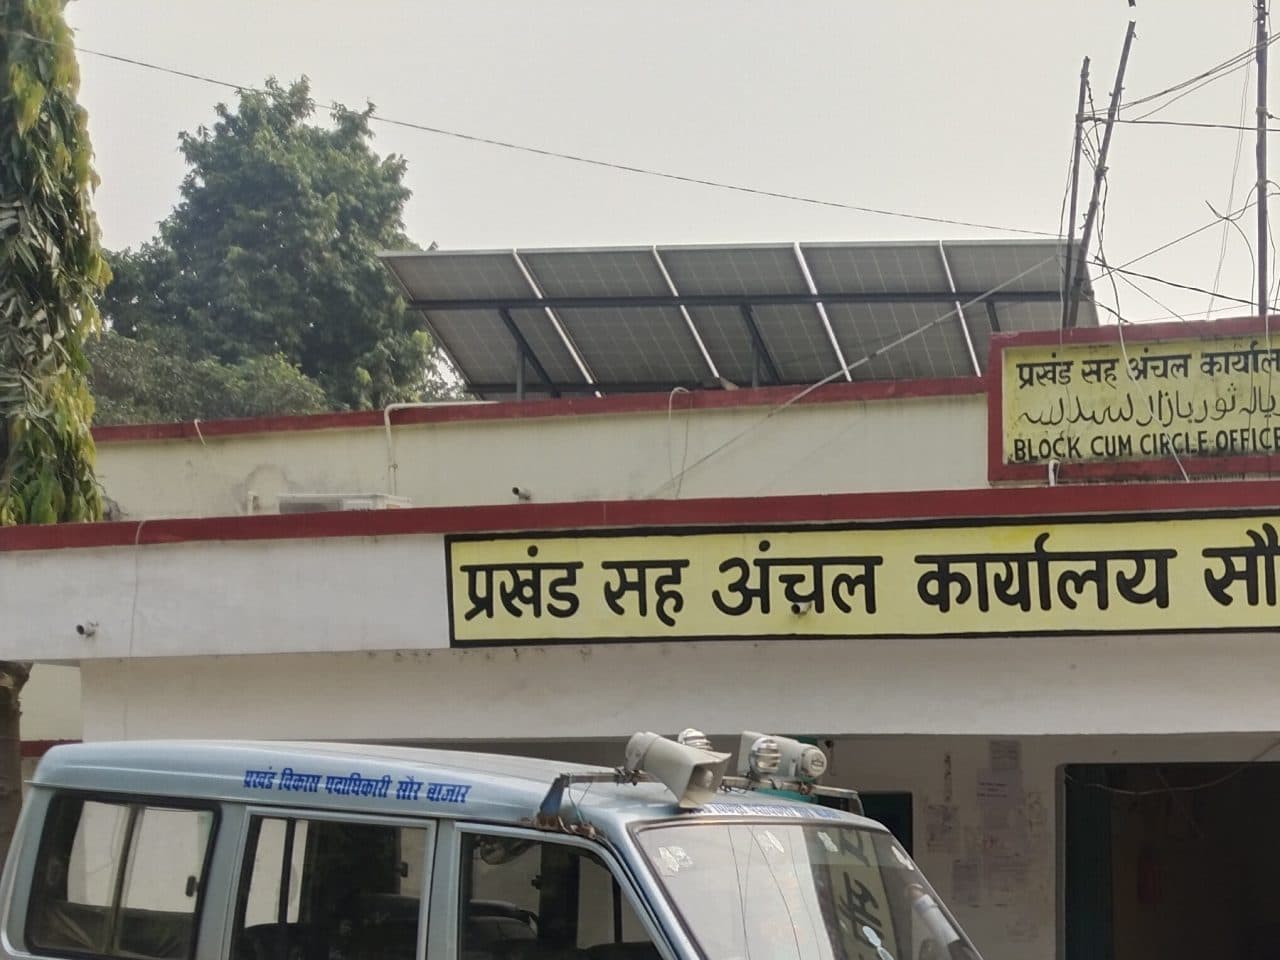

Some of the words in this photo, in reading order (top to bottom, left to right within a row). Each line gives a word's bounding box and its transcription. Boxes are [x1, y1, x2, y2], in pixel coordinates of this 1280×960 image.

[1016, 352, 1074, 389] प्रखंड
[1081, 358, 1120, 389] सह
[1128, 347, 1192, 381] अंचल
[1013, 434, 1082, 461] BLOCK
[1091, 434, 1132, 458] CUM
[1140, 431, 1208, 455] CIRCLE
[459, 545, 584, 622] प्रखंड
[601, 558, 690, 627] सह
[711, 539, 883, 615] अंचल
[914, 532, 1178, 613] कार्यालय
[278, 767, 323, 793] विकास
[427, 781, 473, 804] बाजार
